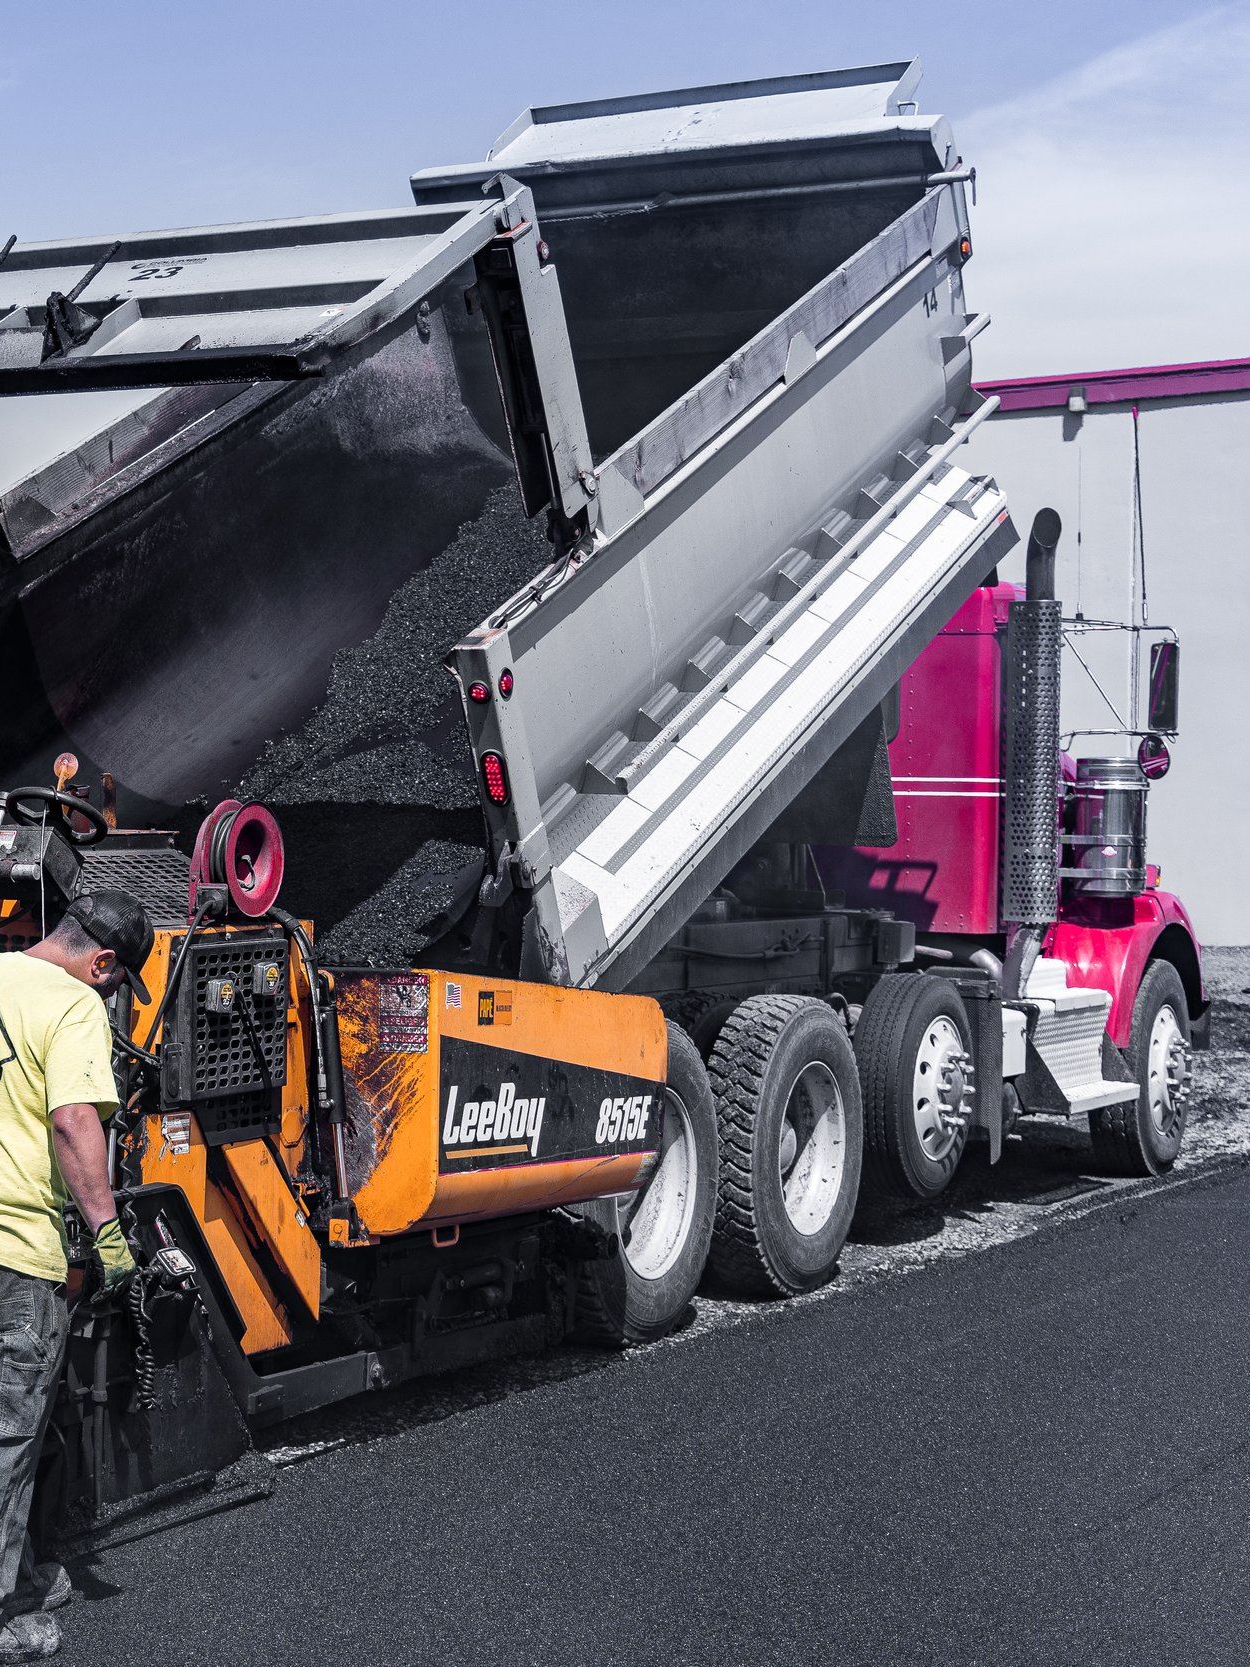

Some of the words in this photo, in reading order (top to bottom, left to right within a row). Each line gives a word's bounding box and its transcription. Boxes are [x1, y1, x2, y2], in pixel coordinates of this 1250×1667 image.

[128, 266, 183, 281] 23
[923, 287, 938, 318] 14
[443, 1082, 546, 1157] LeeBoy
[595, 1095, 652, 1144] 8515E
